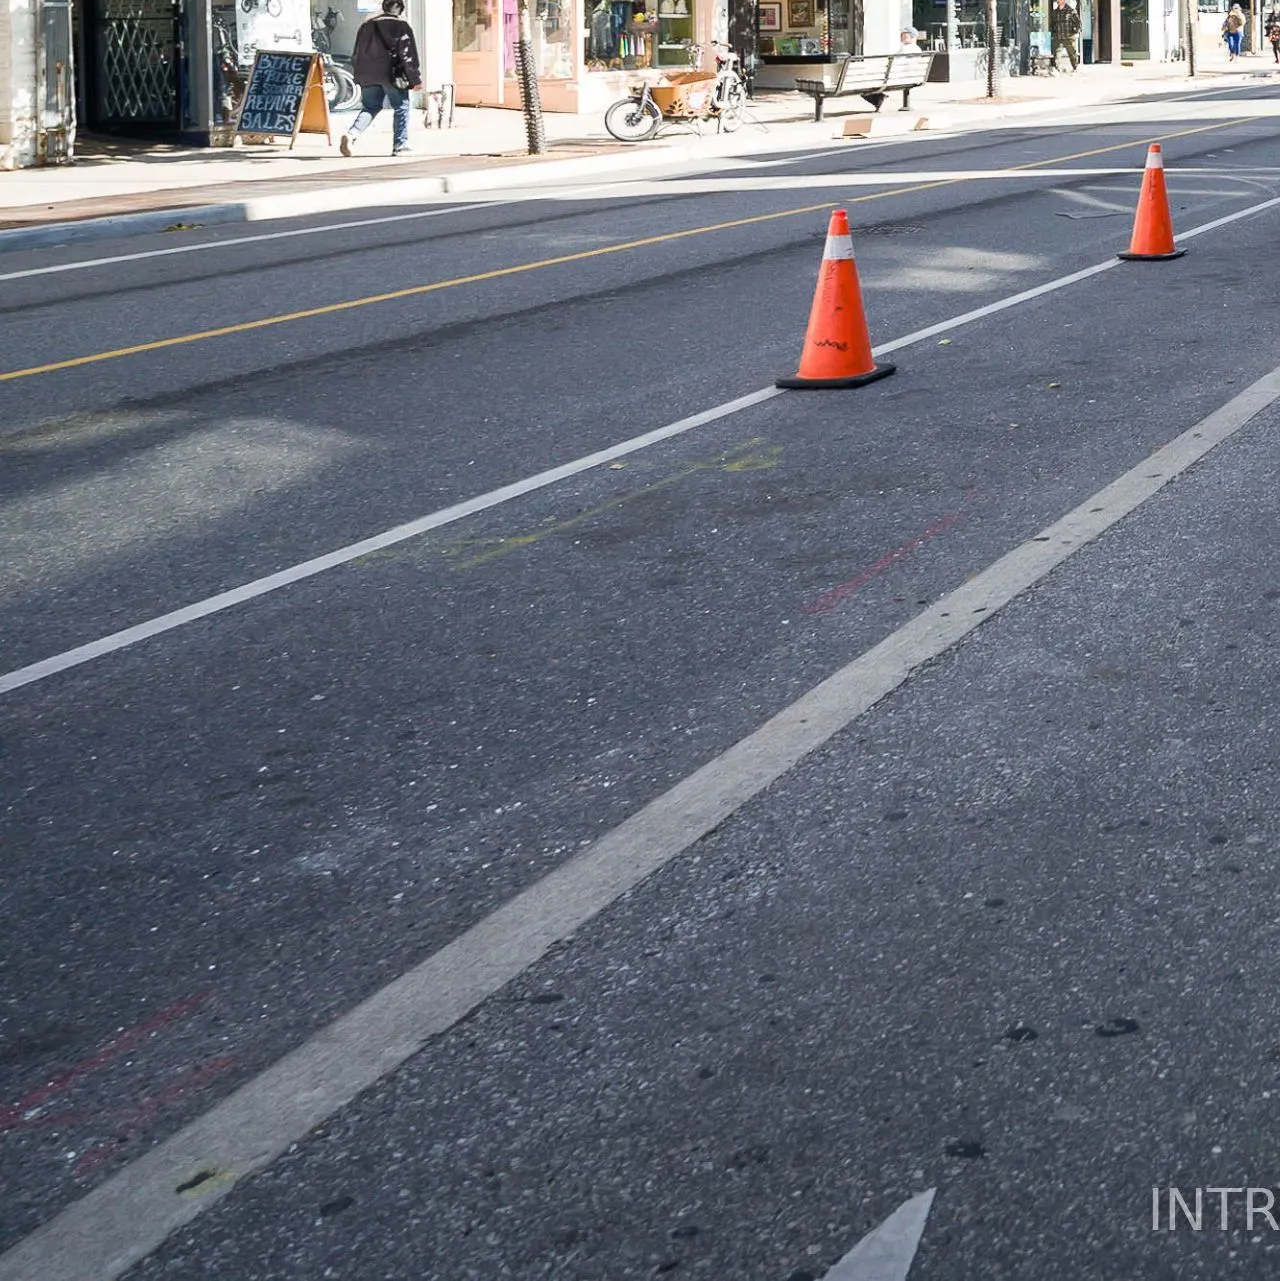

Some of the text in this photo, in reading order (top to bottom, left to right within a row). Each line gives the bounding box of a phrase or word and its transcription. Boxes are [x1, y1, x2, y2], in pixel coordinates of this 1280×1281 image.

[258, 53, 304, 71] BIKE
[245, 94, 297, 113] REPAIR
[242, 112, 296, 132] SALES
